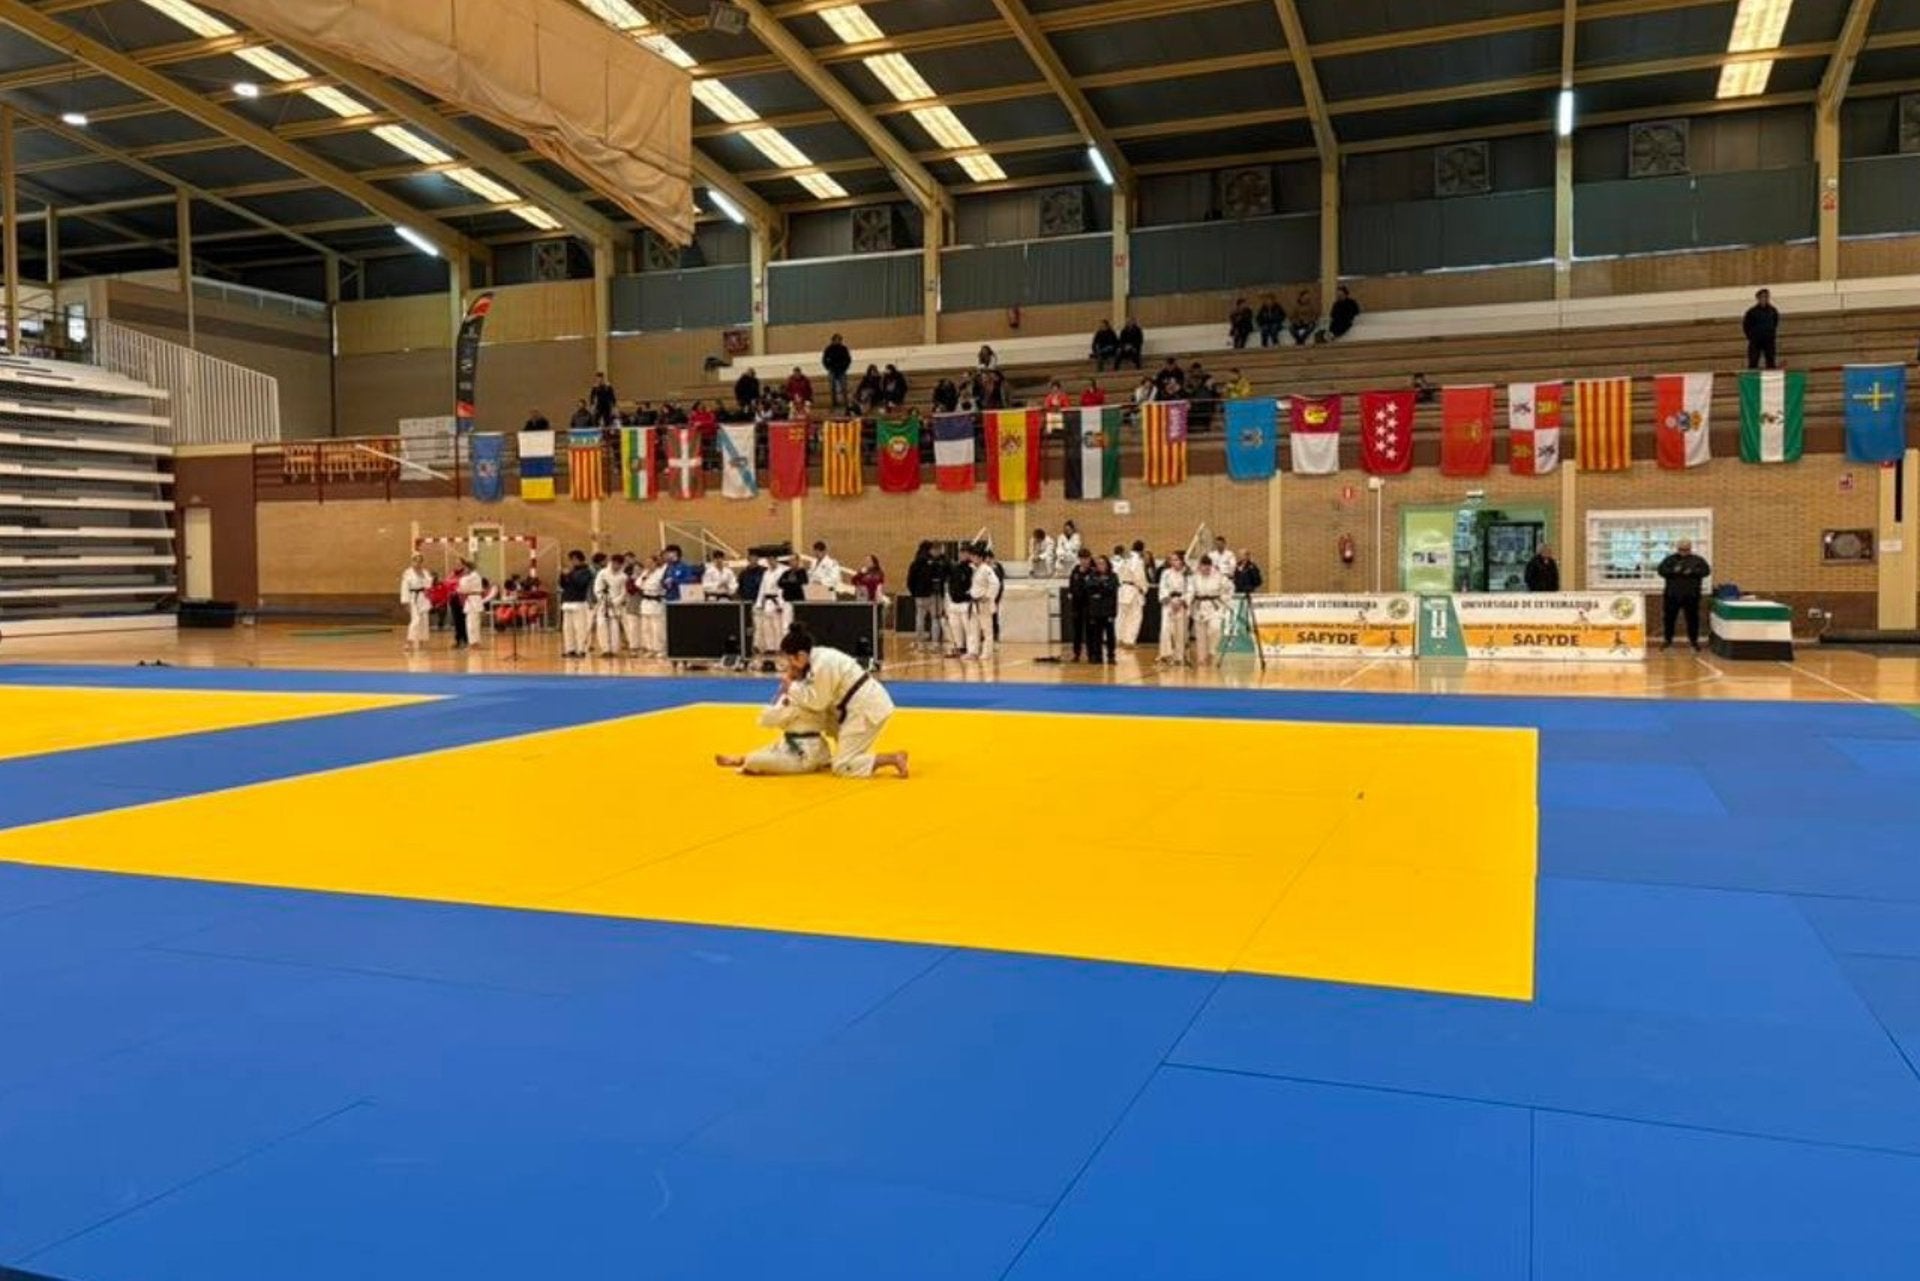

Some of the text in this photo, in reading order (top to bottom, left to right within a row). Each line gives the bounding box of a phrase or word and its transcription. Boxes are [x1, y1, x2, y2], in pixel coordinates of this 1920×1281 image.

[1522, 600, 1531, 609] DE
[1297, 632, 1359, 645] SAFYDE
[1513, 633, 1579, 646] SAFYDE
